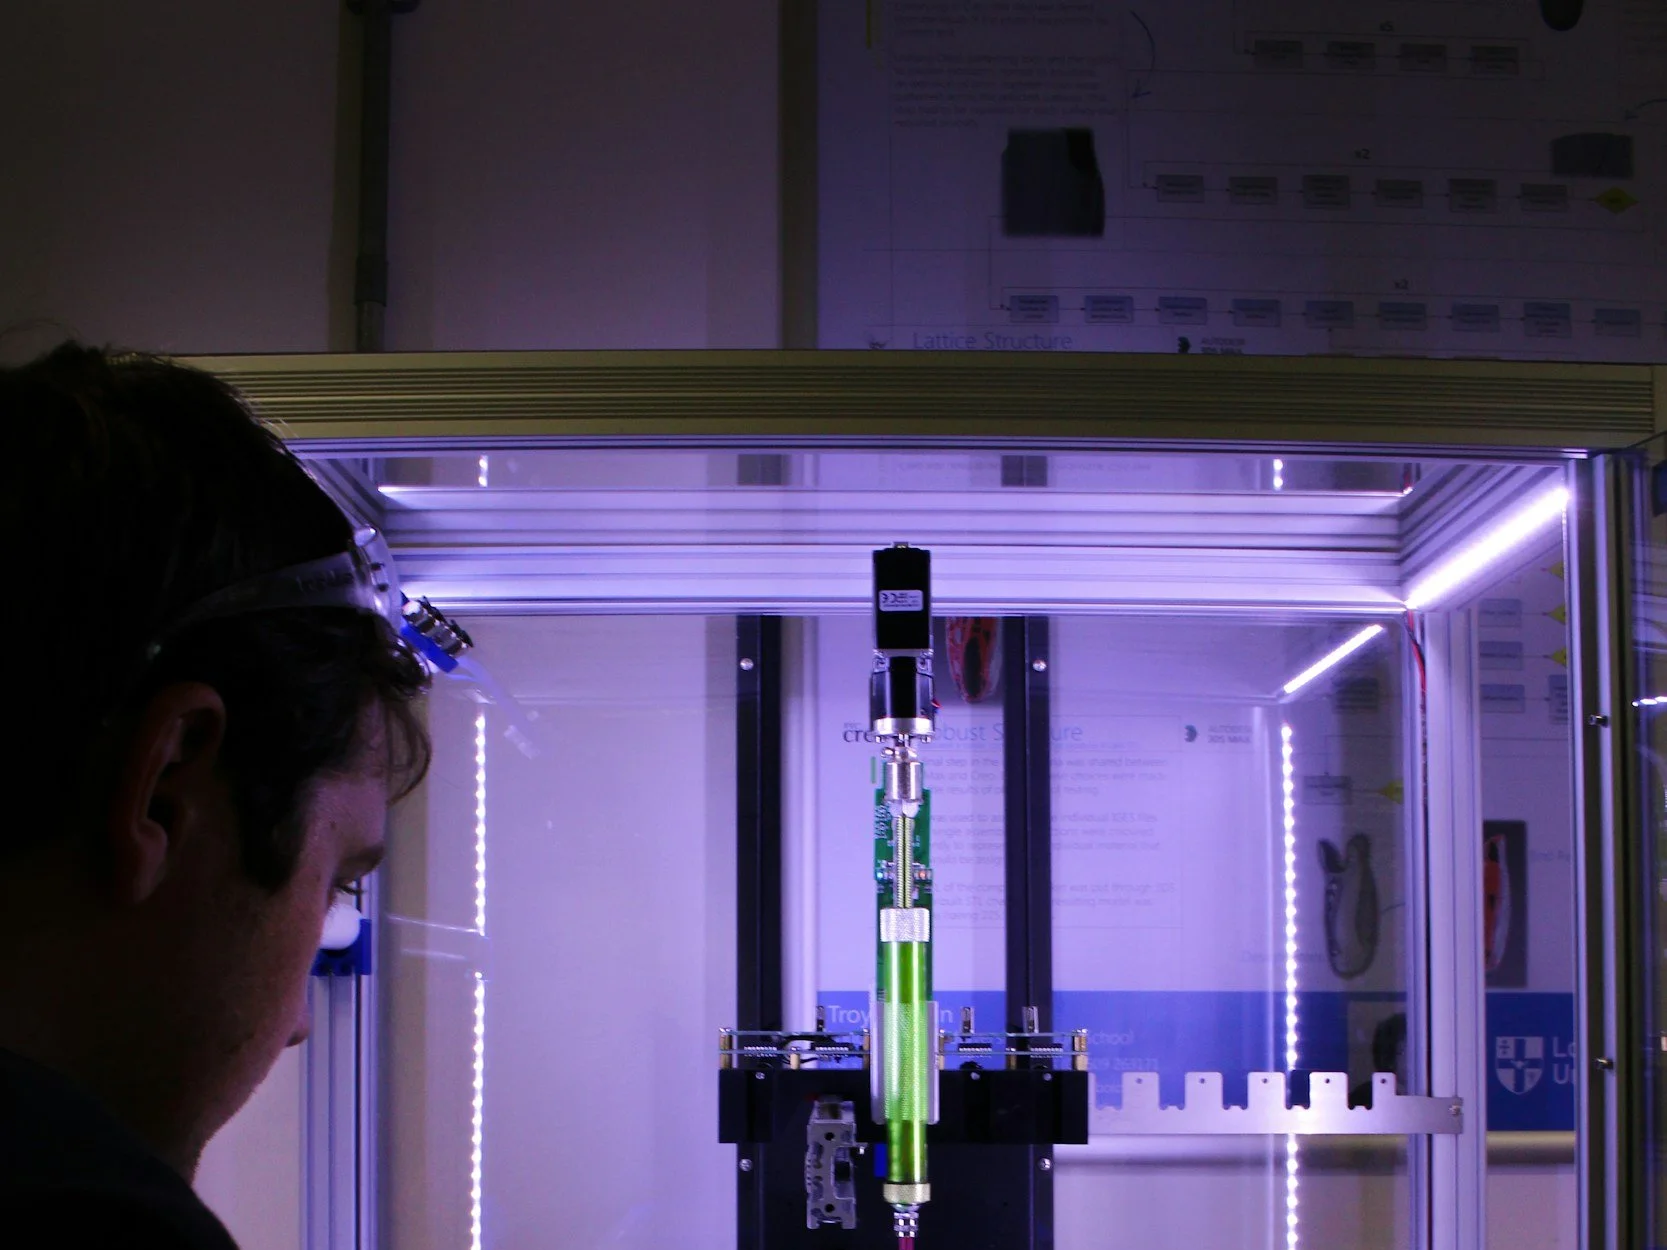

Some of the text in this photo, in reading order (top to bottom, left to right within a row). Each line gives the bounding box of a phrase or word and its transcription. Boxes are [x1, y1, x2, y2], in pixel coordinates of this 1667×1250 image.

[913, 330, 1072, 350] Lattice Structure
[933, 722, 987, 741] obust
[827, 1004, 871, 1030] Troy
